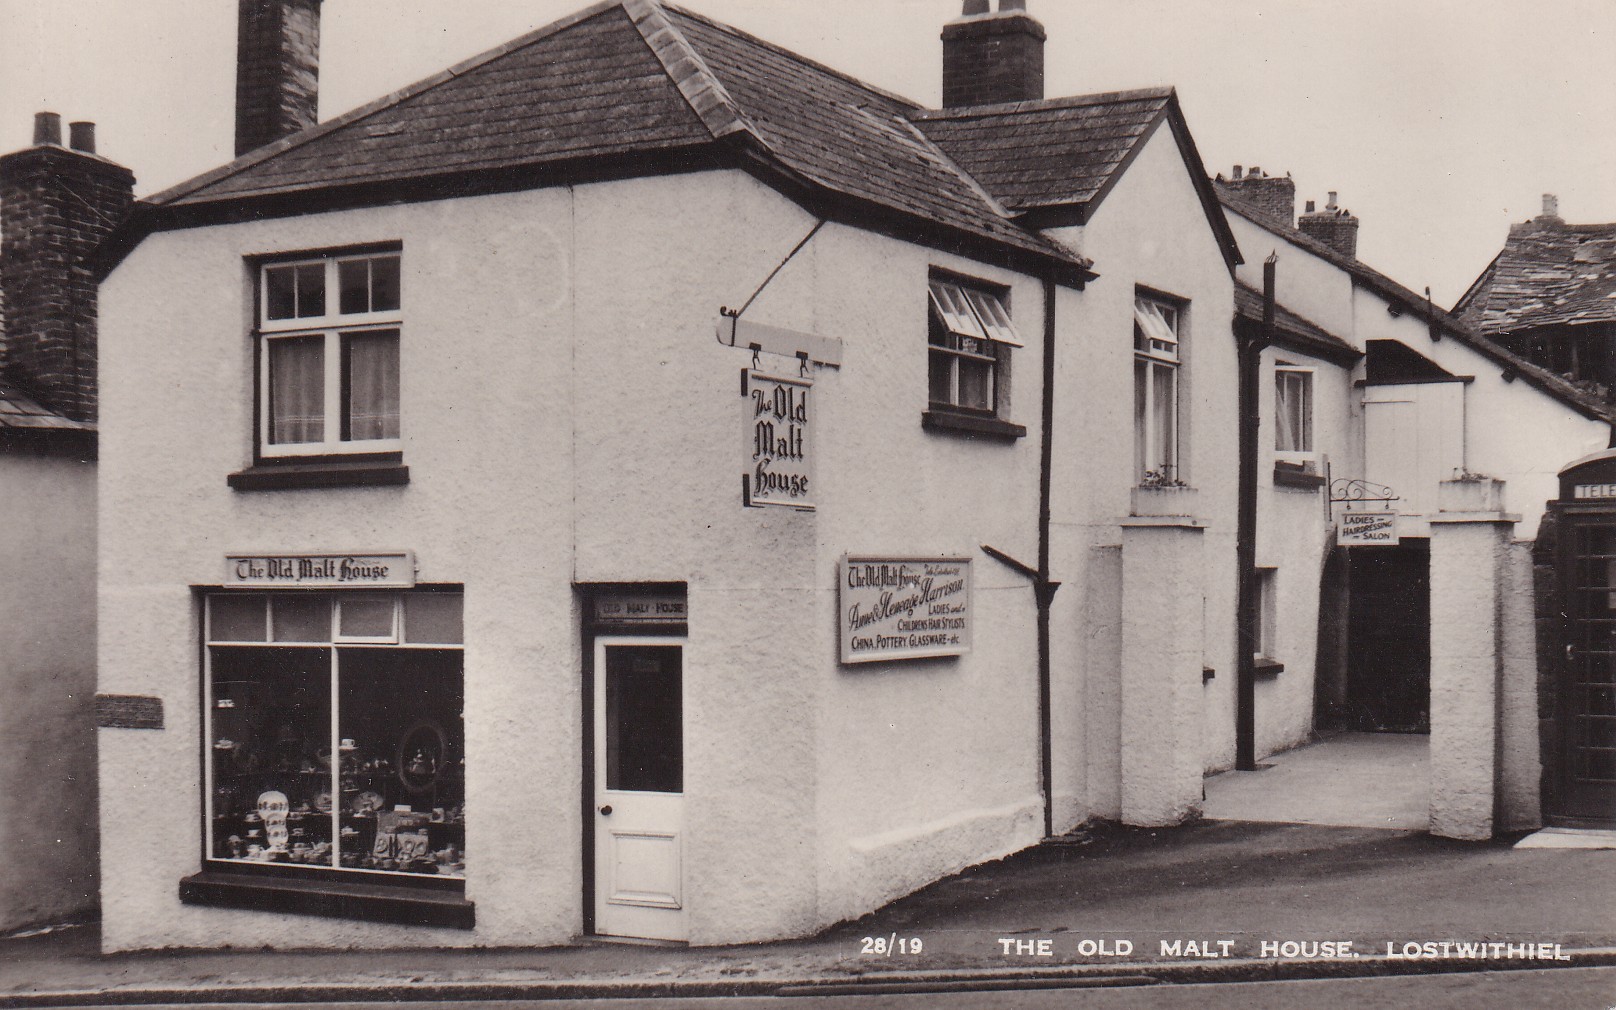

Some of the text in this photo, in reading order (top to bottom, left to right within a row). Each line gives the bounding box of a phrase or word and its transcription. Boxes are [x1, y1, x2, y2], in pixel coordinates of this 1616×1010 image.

[752, 384, 807, 424] The Old
[753, 420, 804, 462] Malt
[1344, 516, 1375, 525] LADIES
[1343, 521, 1393, 536] HAIRDRESSING
[1363, 532, 1390, 540] SALON
[237, 557, 389, 581] The Old Malt House
[848, 566, 865, 588] The
[865, 564, 881, 587] Old
[881, 564, 897, 590] Malt
[919, 577, 963, 605] Harrison
[656, 602, 684, 614] HOUSE
[928, 603, 950, 616] LADIES
[928, 618, 941, 630] HAIR
[942, 617, 965, 630] STYLISTS
